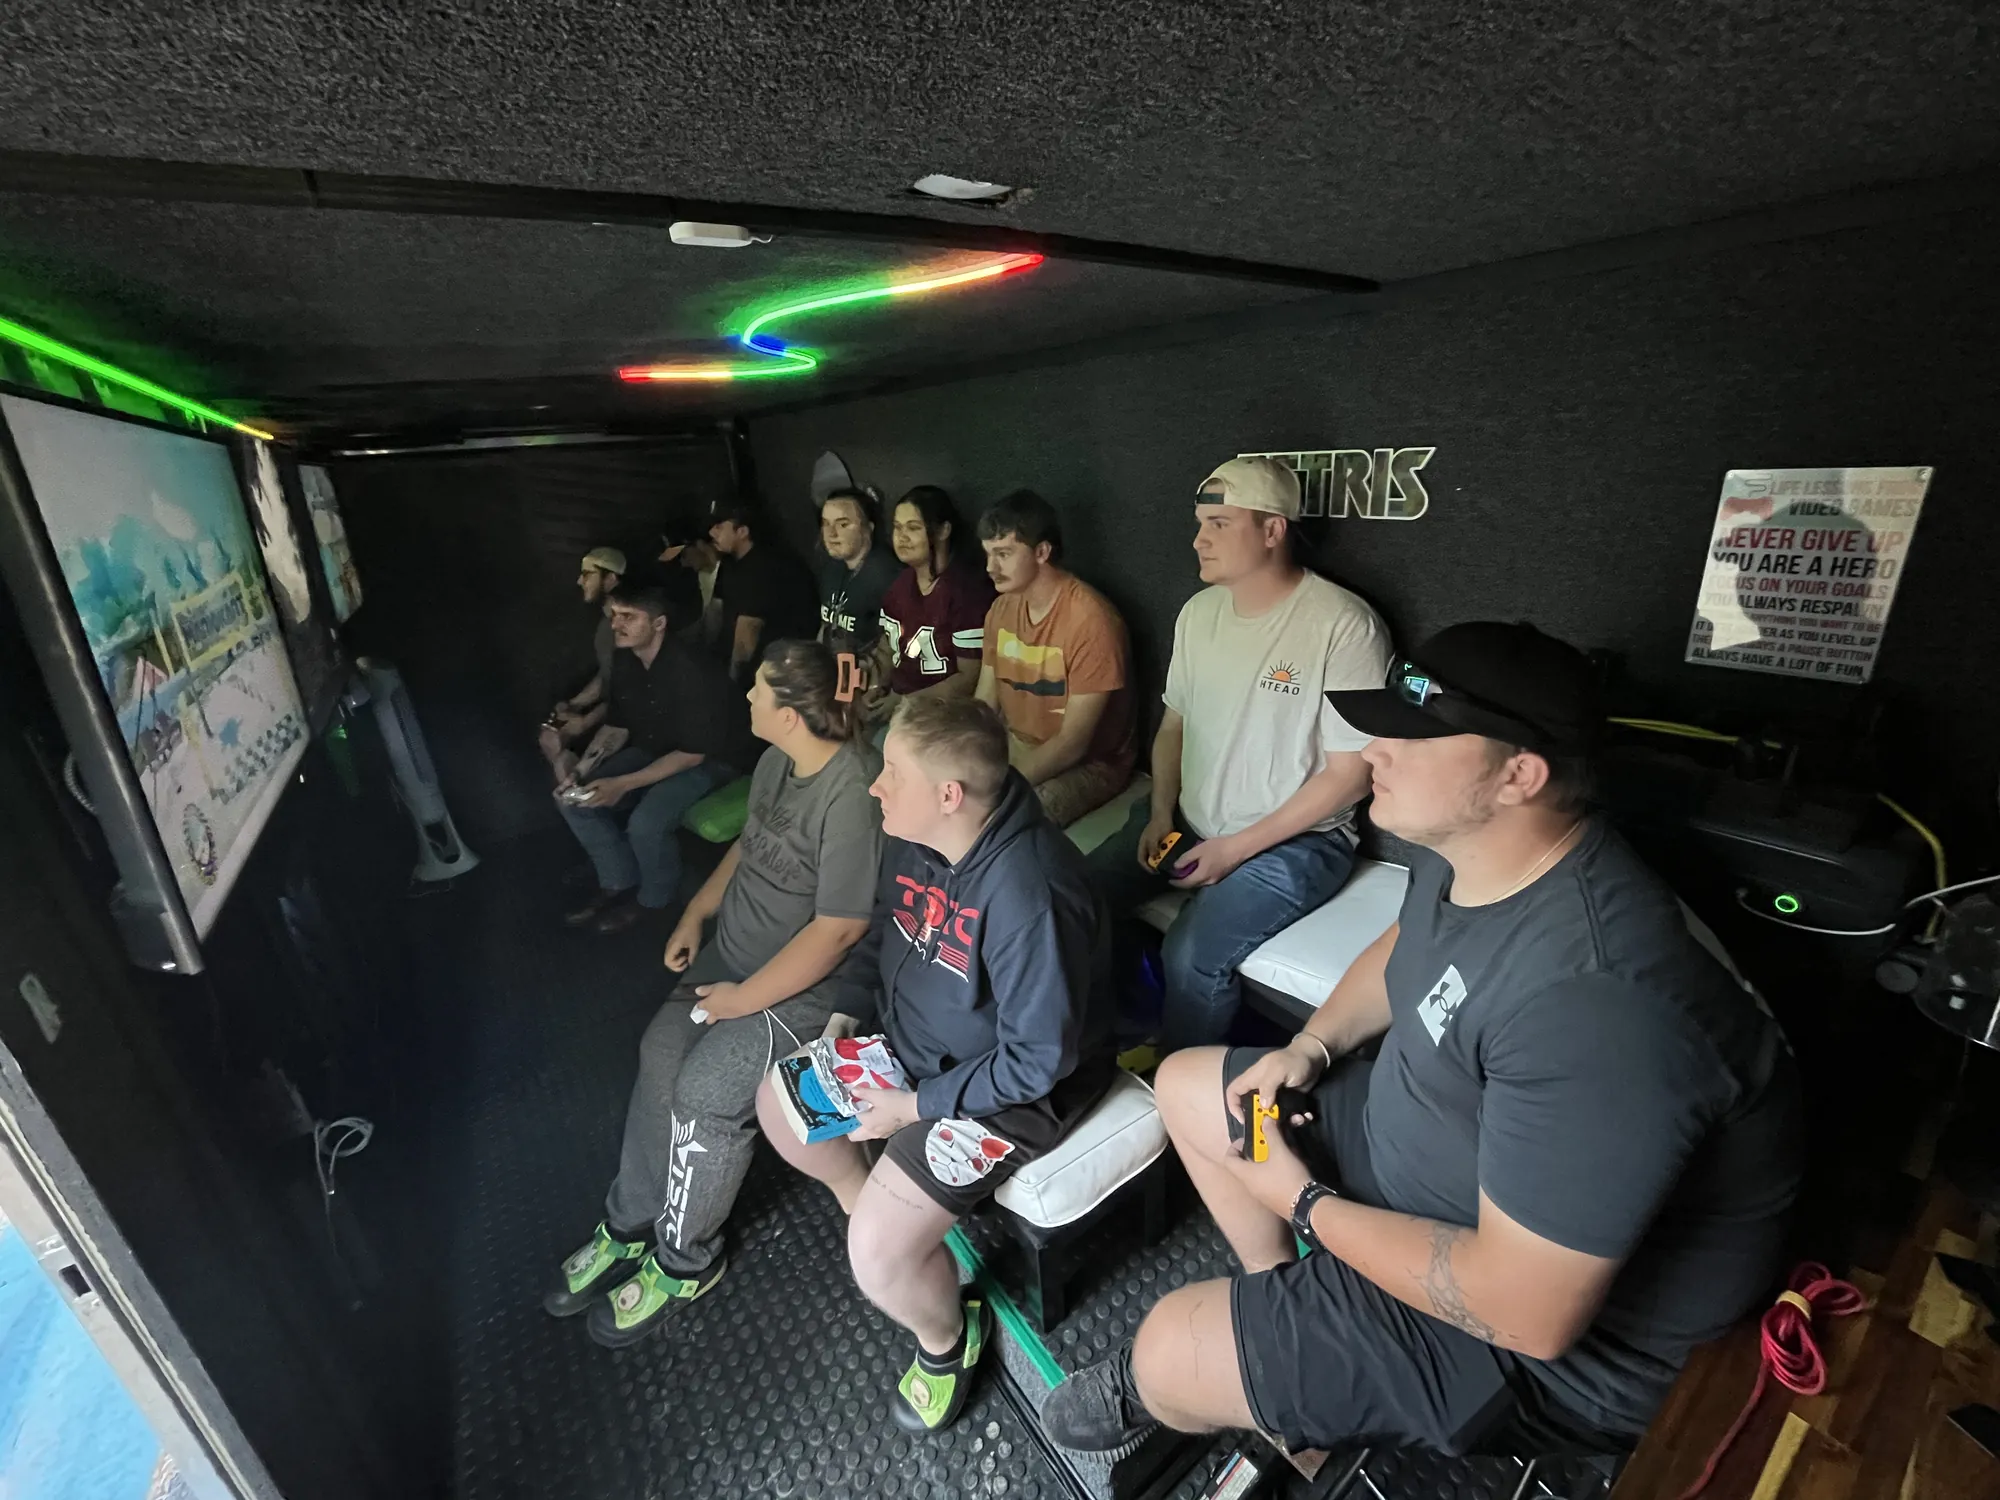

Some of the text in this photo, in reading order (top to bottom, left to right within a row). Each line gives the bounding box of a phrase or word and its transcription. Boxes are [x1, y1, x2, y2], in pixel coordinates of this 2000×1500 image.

[1237, 447, 1437, 520] TRIS
[1716, 527, 1906, 554] NEVER GIVE UP
[1712, 551, 1897, 580] YOU ARE A HERO
[1758, 577, 1780, 593] ON
[1785, 579, 1828, 596] YOUR
[1831, 580, 1889, 600] GOALS
[1737, 594, 1797, 612] ALWAYS
[1851, 621, 1866, 632] TO
[1779, 628, 1795, 639] AS
[1798, 630, 1819, 642] YOU
[1822, 633, 1859, 646] LEVEL
[1859, 637, 1877, 647] UP
[1692, 647, 1864, 677] ALWAYS HAVE A LOT OF FUN
[1777, 643, 1786, 653] A
[1788, 643, 1825, 657] PAUSE
[1826, 647, 1873, 661] BUTTON
[1259, 679, 1300, 696] HTEAO
